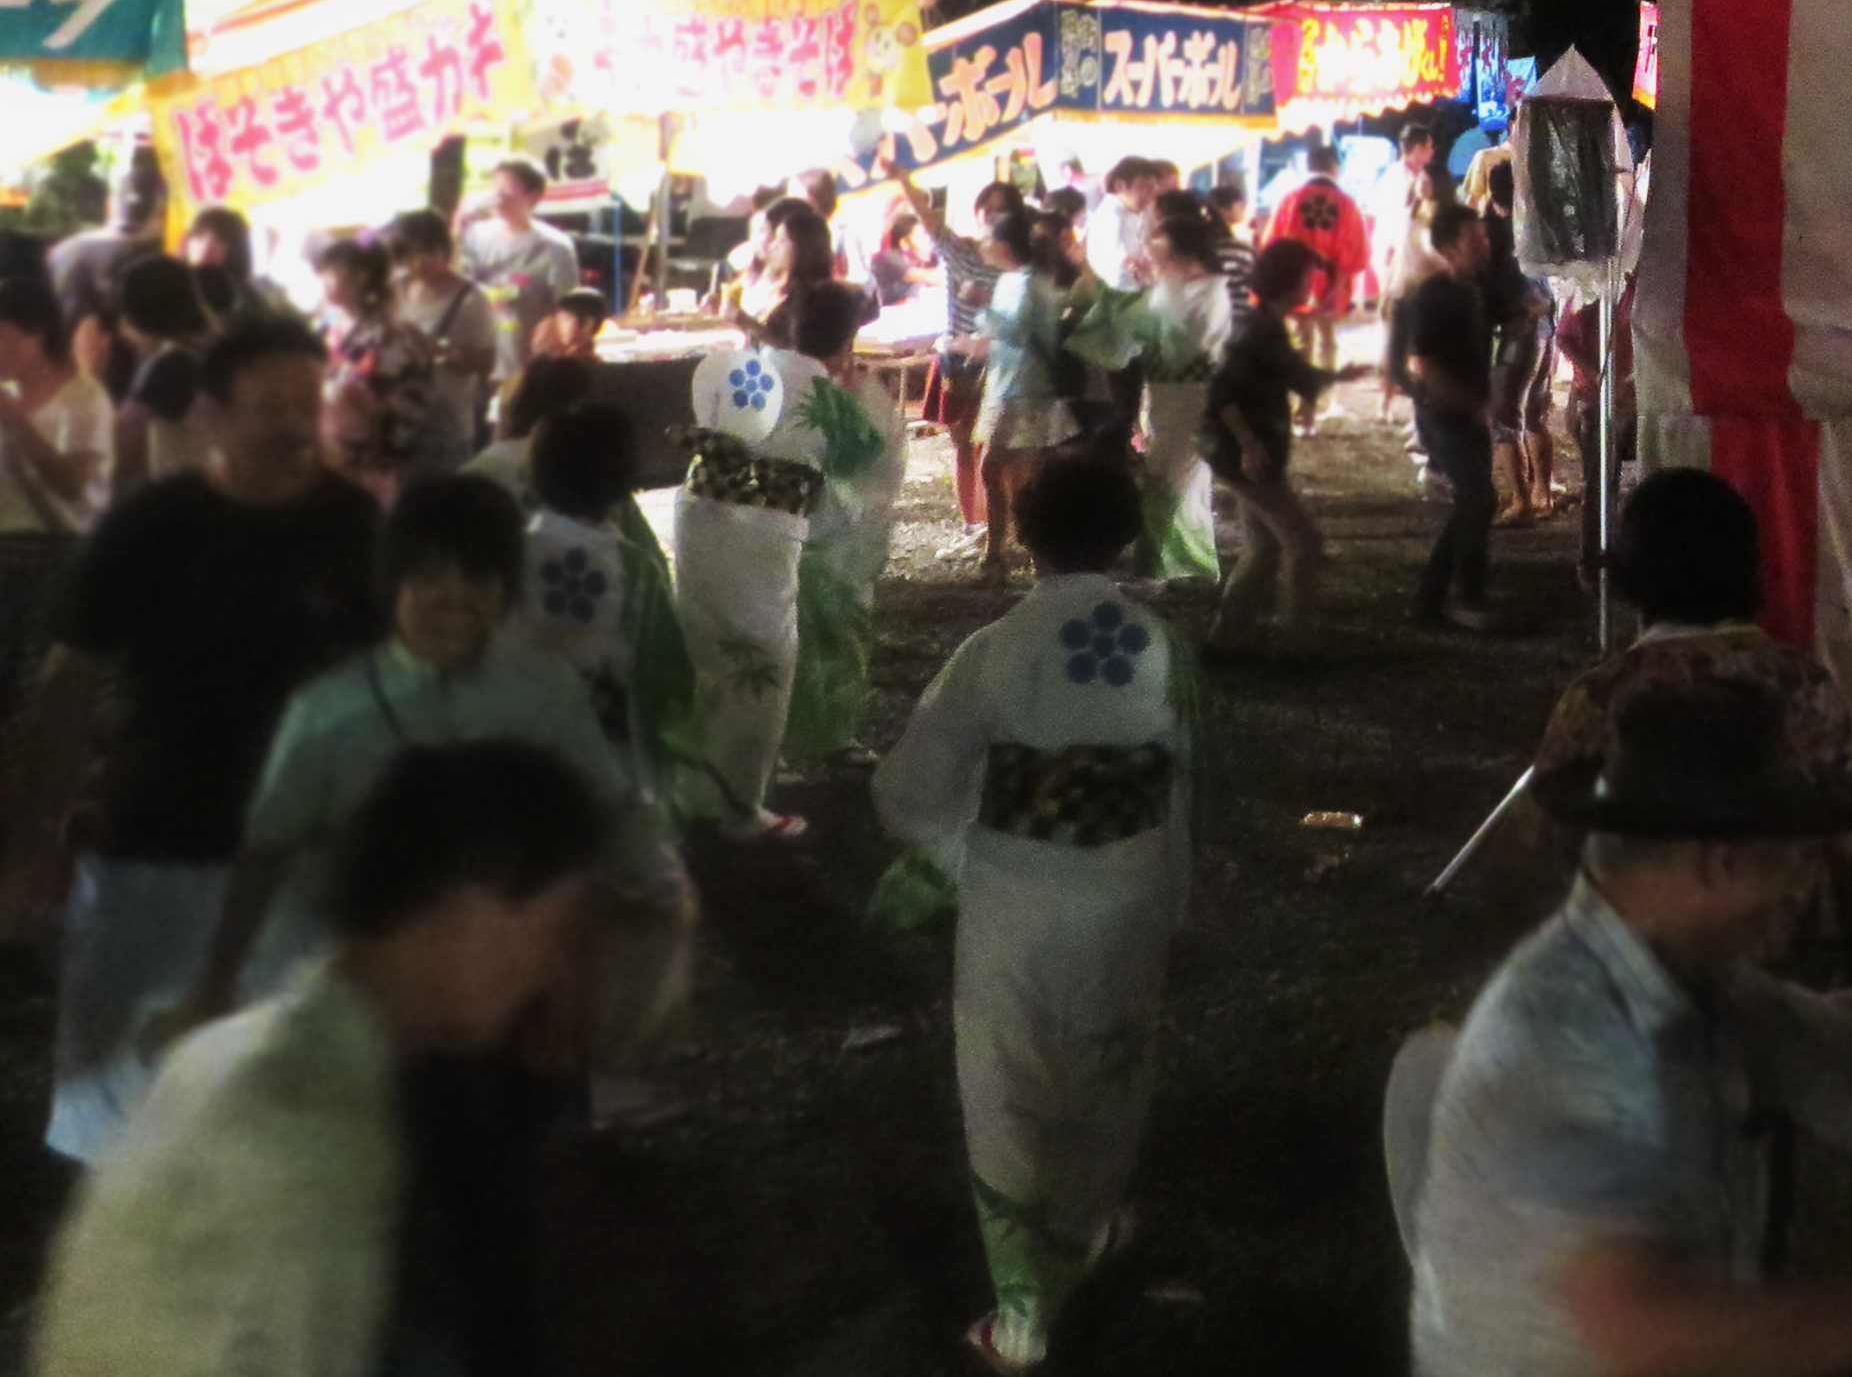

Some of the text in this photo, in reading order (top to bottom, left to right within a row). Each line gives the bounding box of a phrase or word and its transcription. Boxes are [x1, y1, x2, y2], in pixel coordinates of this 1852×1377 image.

[1103, 29, 1242, 111] スーパーボール
